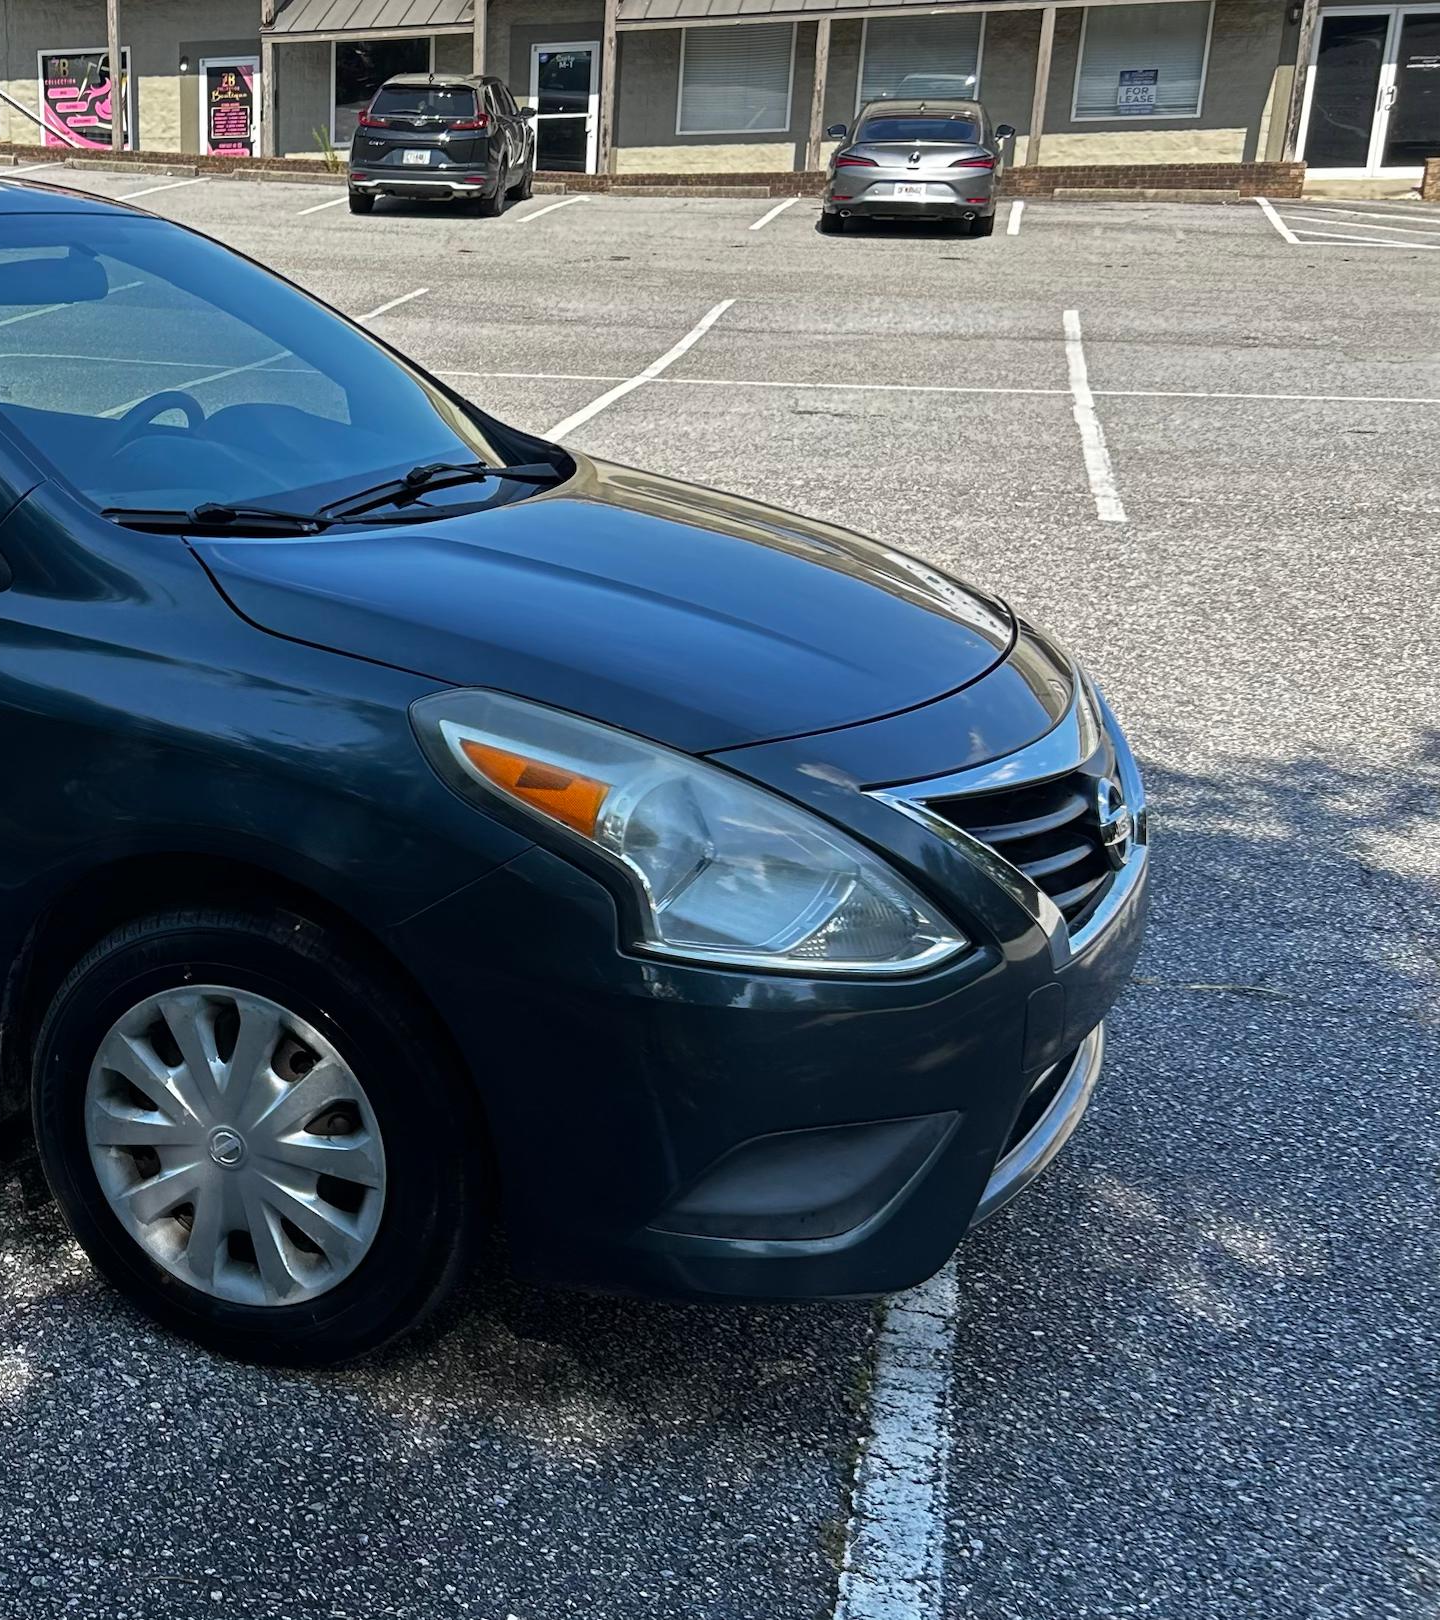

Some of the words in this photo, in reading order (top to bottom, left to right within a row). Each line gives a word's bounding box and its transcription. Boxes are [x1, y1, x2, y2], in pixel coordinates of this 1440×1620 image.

[221, 73, 236, 87] 2B
[211, 90, 247, 102] Boutique
[1126, 87, 1149, 95] FOR
[1119, 95, 1154, 103] LEASE
